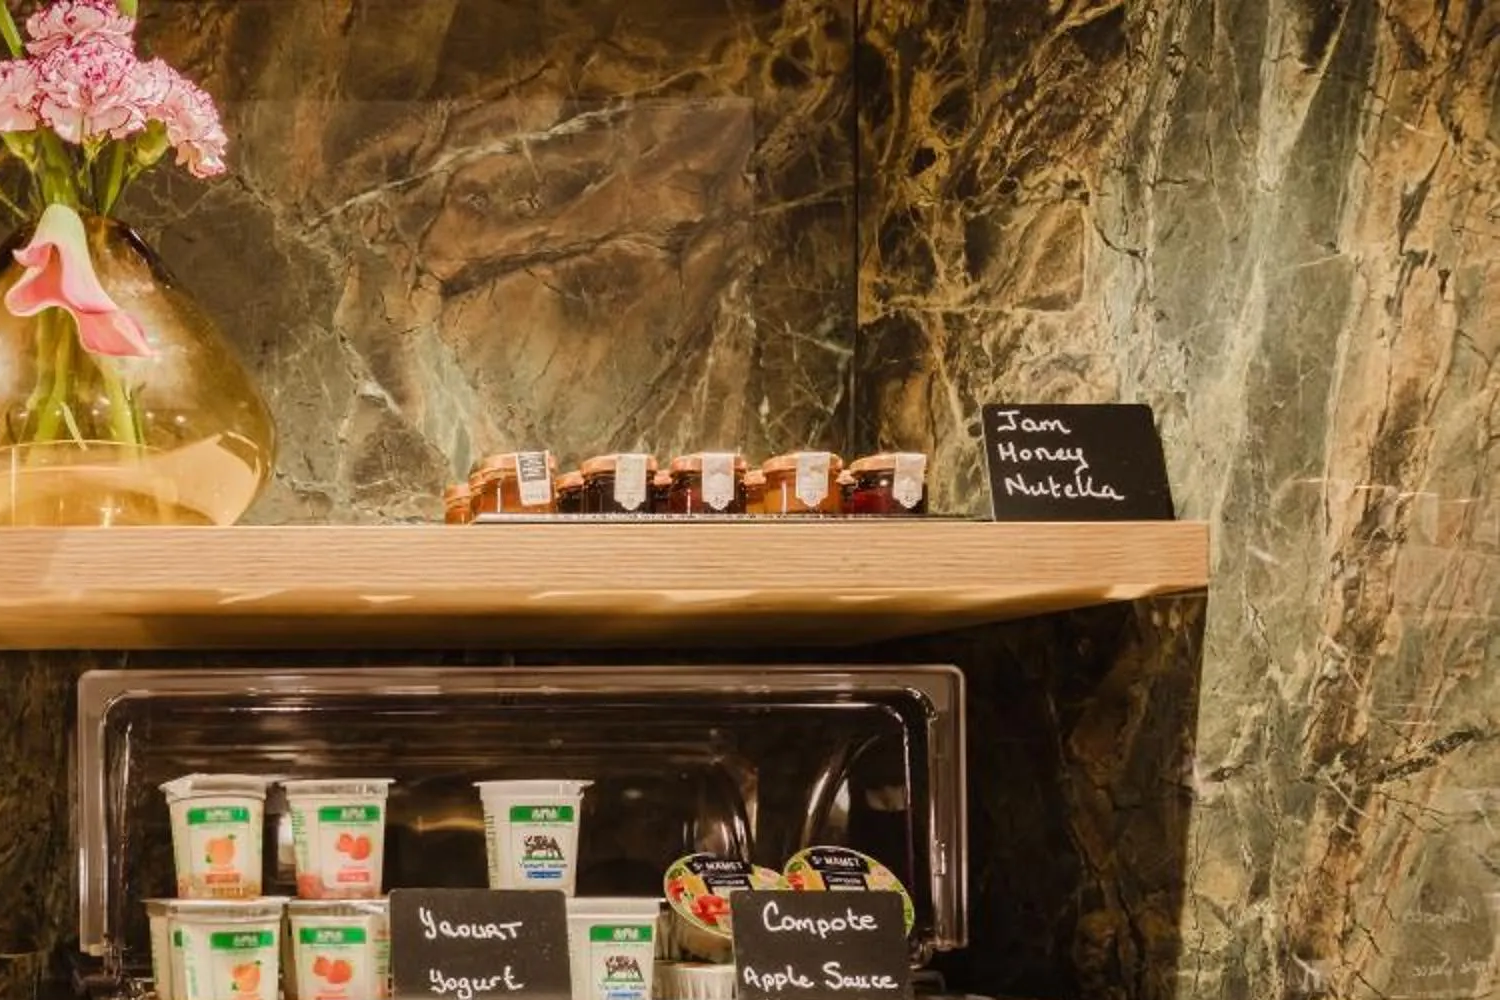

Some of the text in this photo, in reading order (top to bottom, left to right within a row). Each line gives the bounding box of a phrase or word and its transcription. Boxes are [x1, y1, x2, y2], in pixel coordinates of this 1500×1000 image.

[996, 409, 1072, 435] Jam
[996, 441, 1090, 475] Honey
[1004, 472, 1126, 501] Nutella
[762, 900, 879, 939] Compote
[742, 960, 900, 993] Apple Sauce
